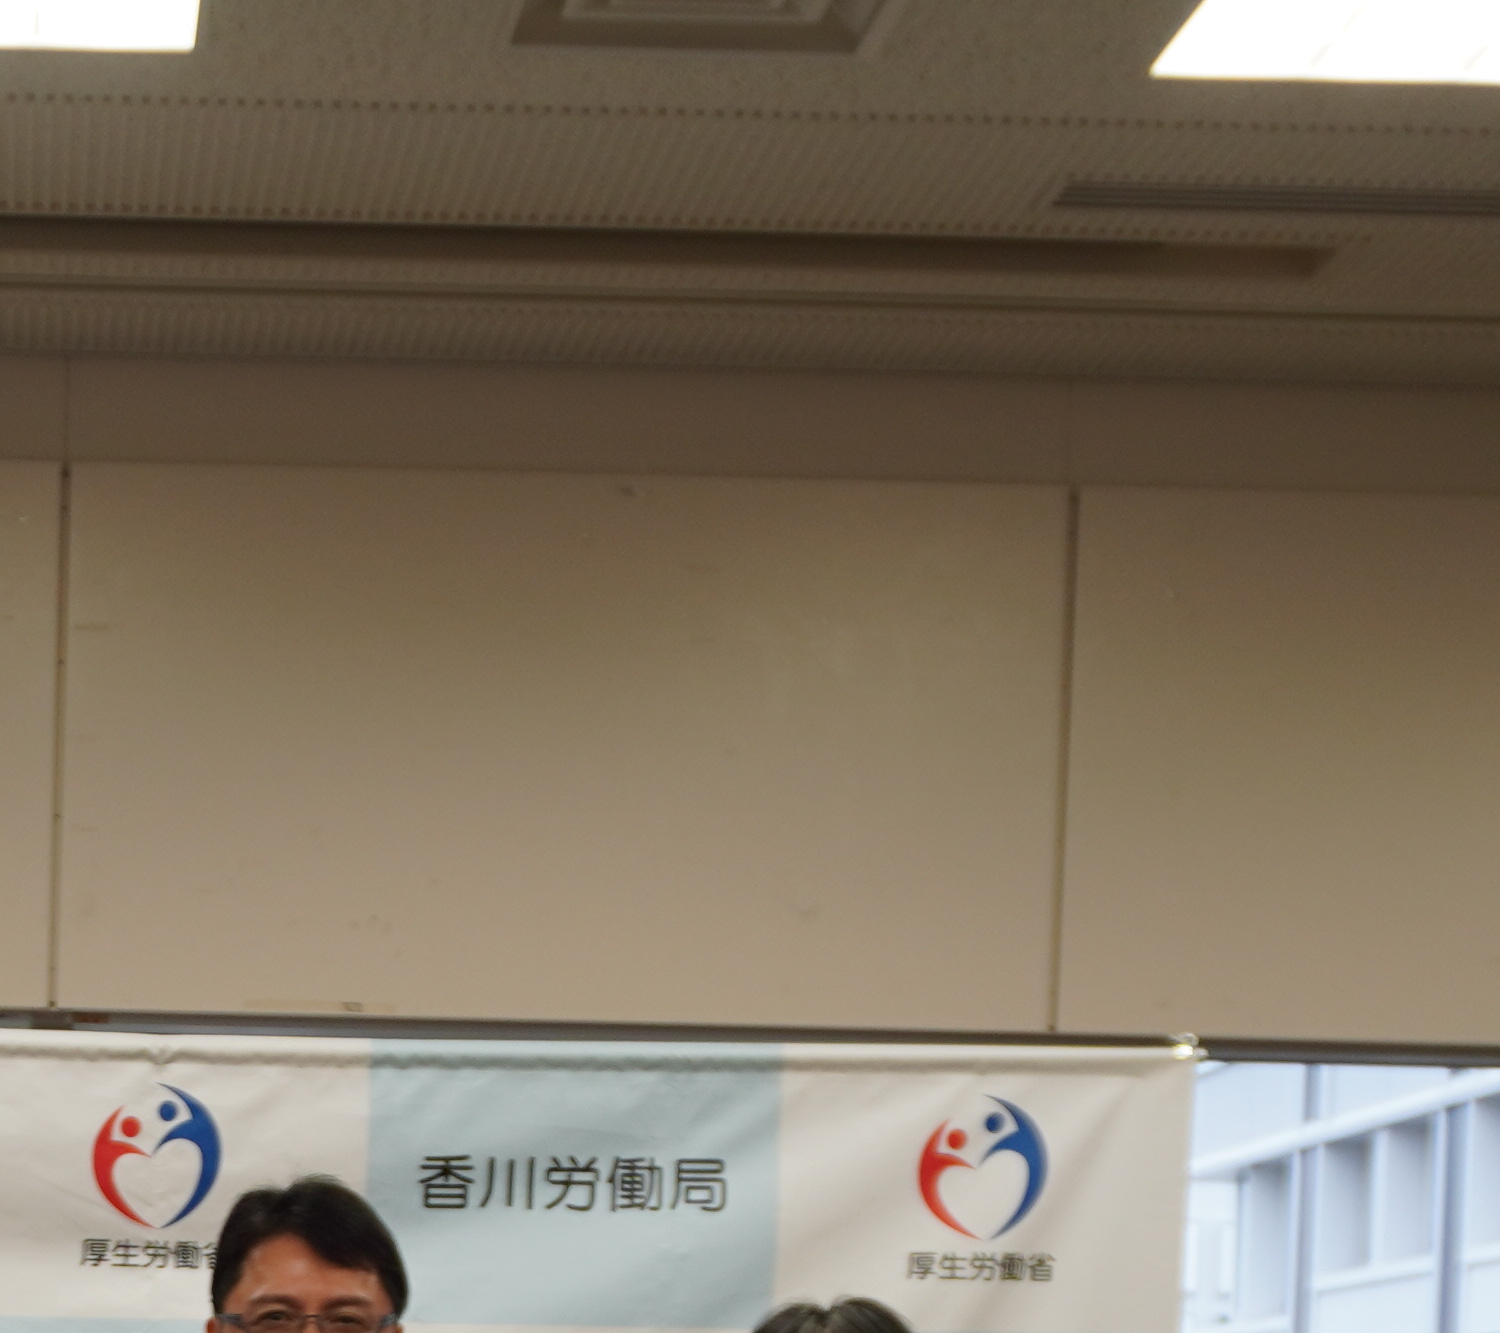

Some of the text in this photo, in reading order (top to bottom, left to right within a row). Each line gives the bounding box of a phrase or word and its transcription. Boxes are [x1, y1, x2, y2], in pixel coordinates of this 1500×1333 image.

[418, 1154, 729, 1213] 香川労働局
[906, 1251, 1057, 1284] 厚生労働省
